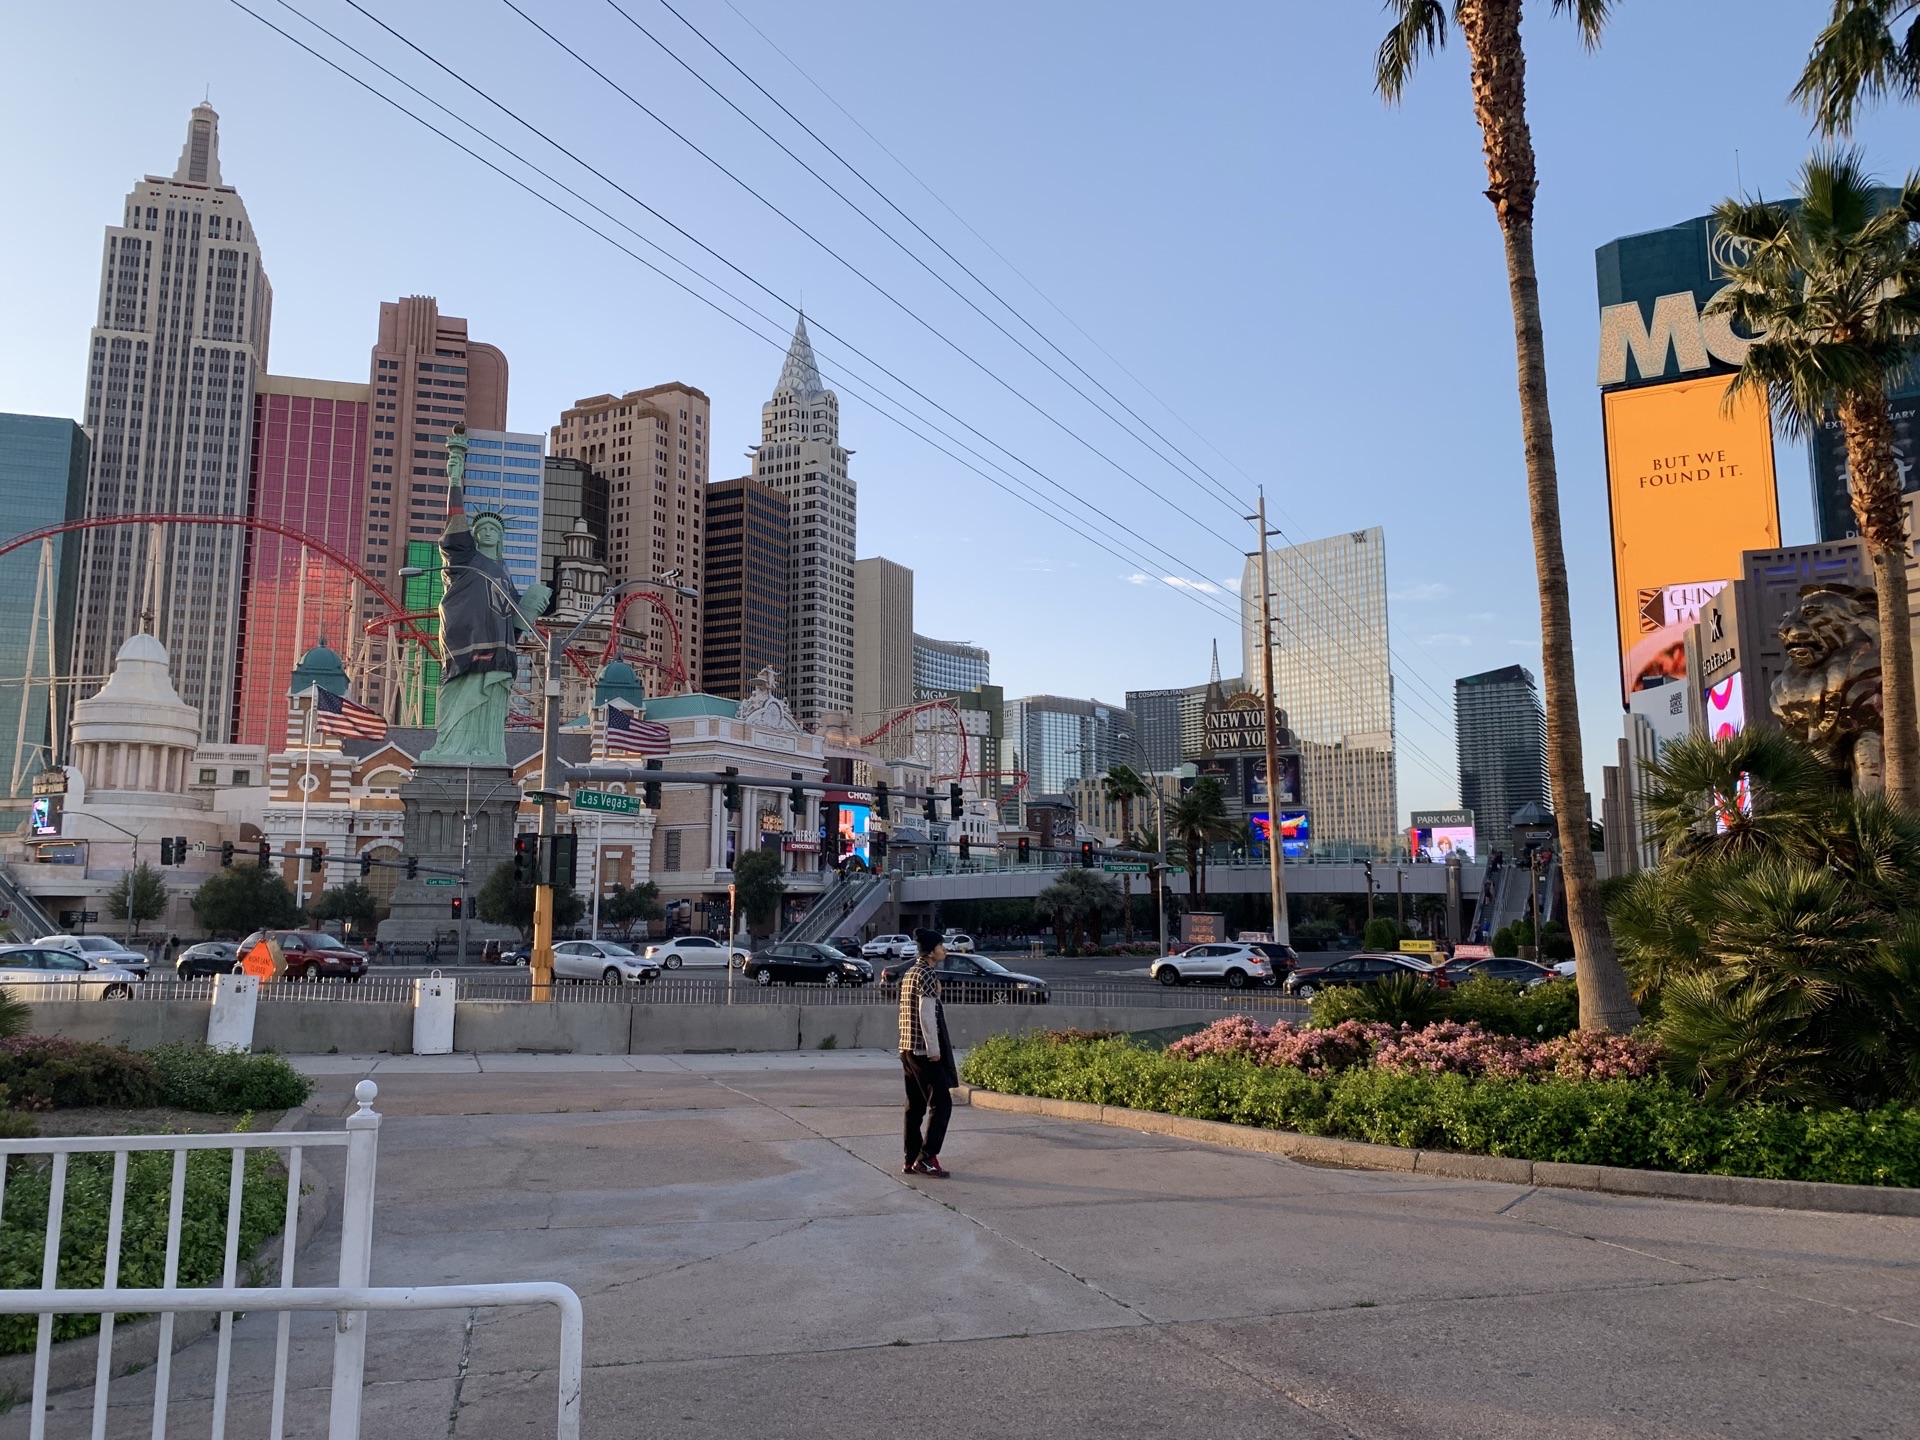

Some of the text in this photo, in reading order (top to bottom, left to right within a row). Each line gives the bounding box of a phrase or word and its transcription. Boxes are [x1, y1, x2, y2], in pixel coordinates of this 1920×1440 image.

[1653, 449, 1726, 471] BUT WE
[1639, 464, 1743, 489] FOUND IT.
[1702, 647, 1734, 677] Hakkasan
[920, 690, 948, 700] MGM
[1125, 689, 1184, 700] THE COSMOPOLITAN
[1210, 712, 1240, 729] NEW
[1210, 732, 1241, 749] NEW
[581, 792, 598, 805] Las
[600, 794, 627, 811] Vegas
[629, 797, 639, 805] BLVD
[628, 806, 640, 814] 3700
[904, 817, 917, 826] IRISH
[1417, 815, 1466, 824] PARK MGM
[1191, 915, 1214, 924] ROAD
[1191, 925, 1214, 934] WORK
[1188, 934, 1216, 943] AHEAD
